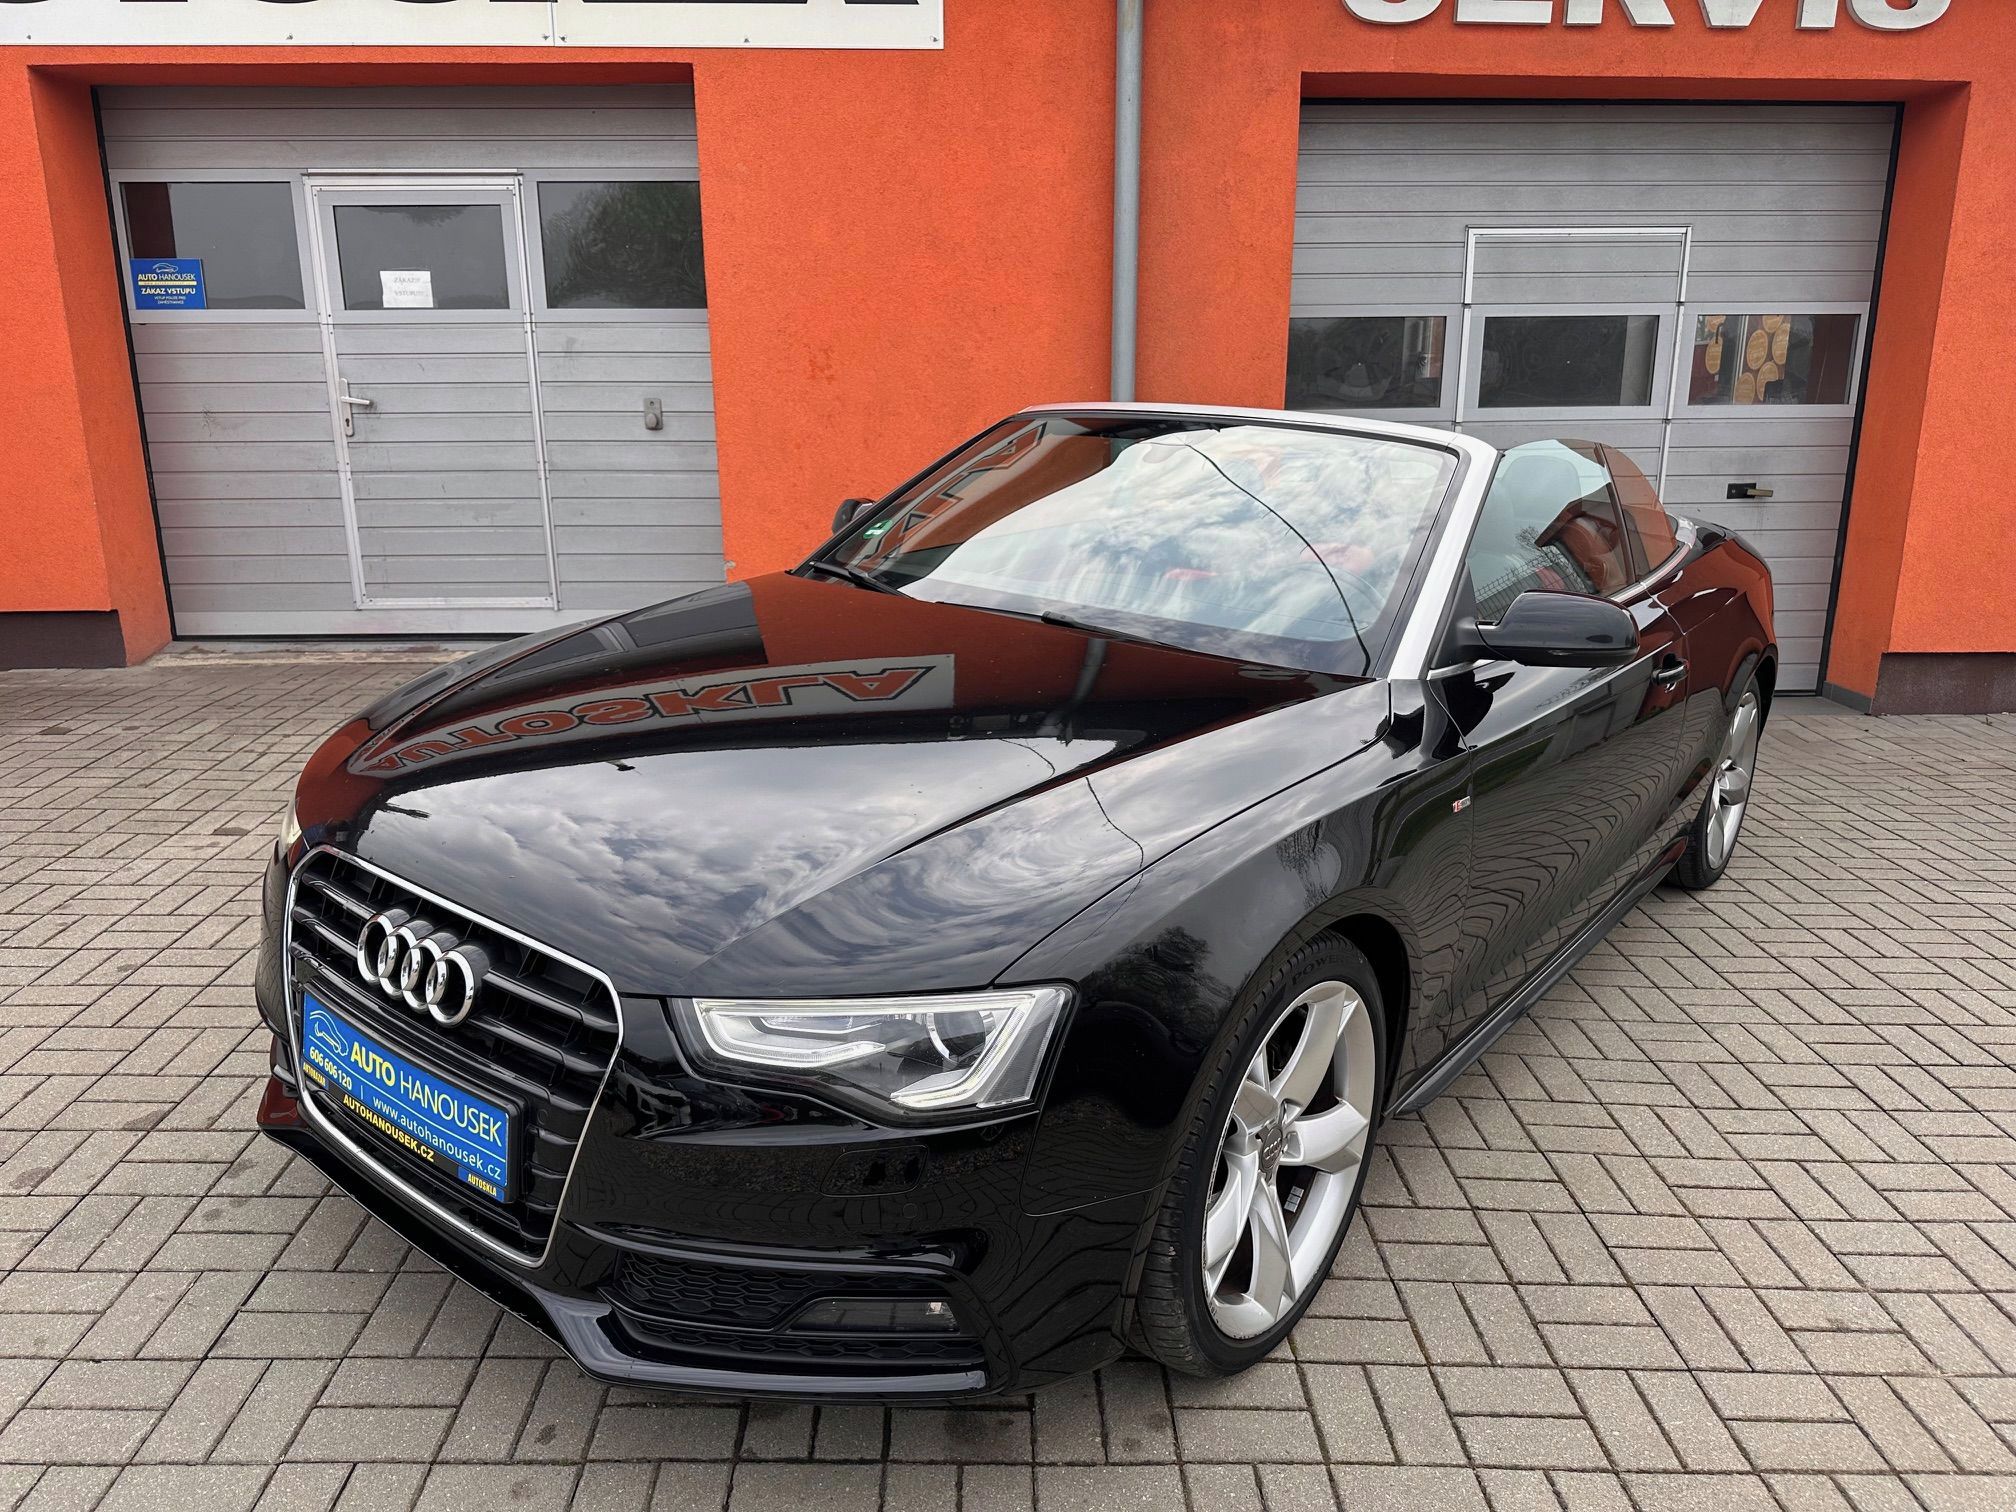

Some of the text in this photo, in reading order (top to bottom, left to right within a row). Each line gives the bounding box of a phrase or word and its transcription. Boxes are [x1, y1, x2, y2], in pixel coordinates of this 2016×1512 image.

[138, 273, 196, 281] AUTO HANOUSEK
[141, 286, 196, 295] ZÁKAZ VSTUPU
[309, 1046, 353, 1091] 606 606 120
[352, 1041, 502, 1147] AUTO HANOUSEK
[343, 1094, 434, 1162] AUTOHANOUSEK.CZ
[373, 1096, 501, 1180] www.autohanousek.cz
[467, 1173, 497, 1197] AUTOSKLA
